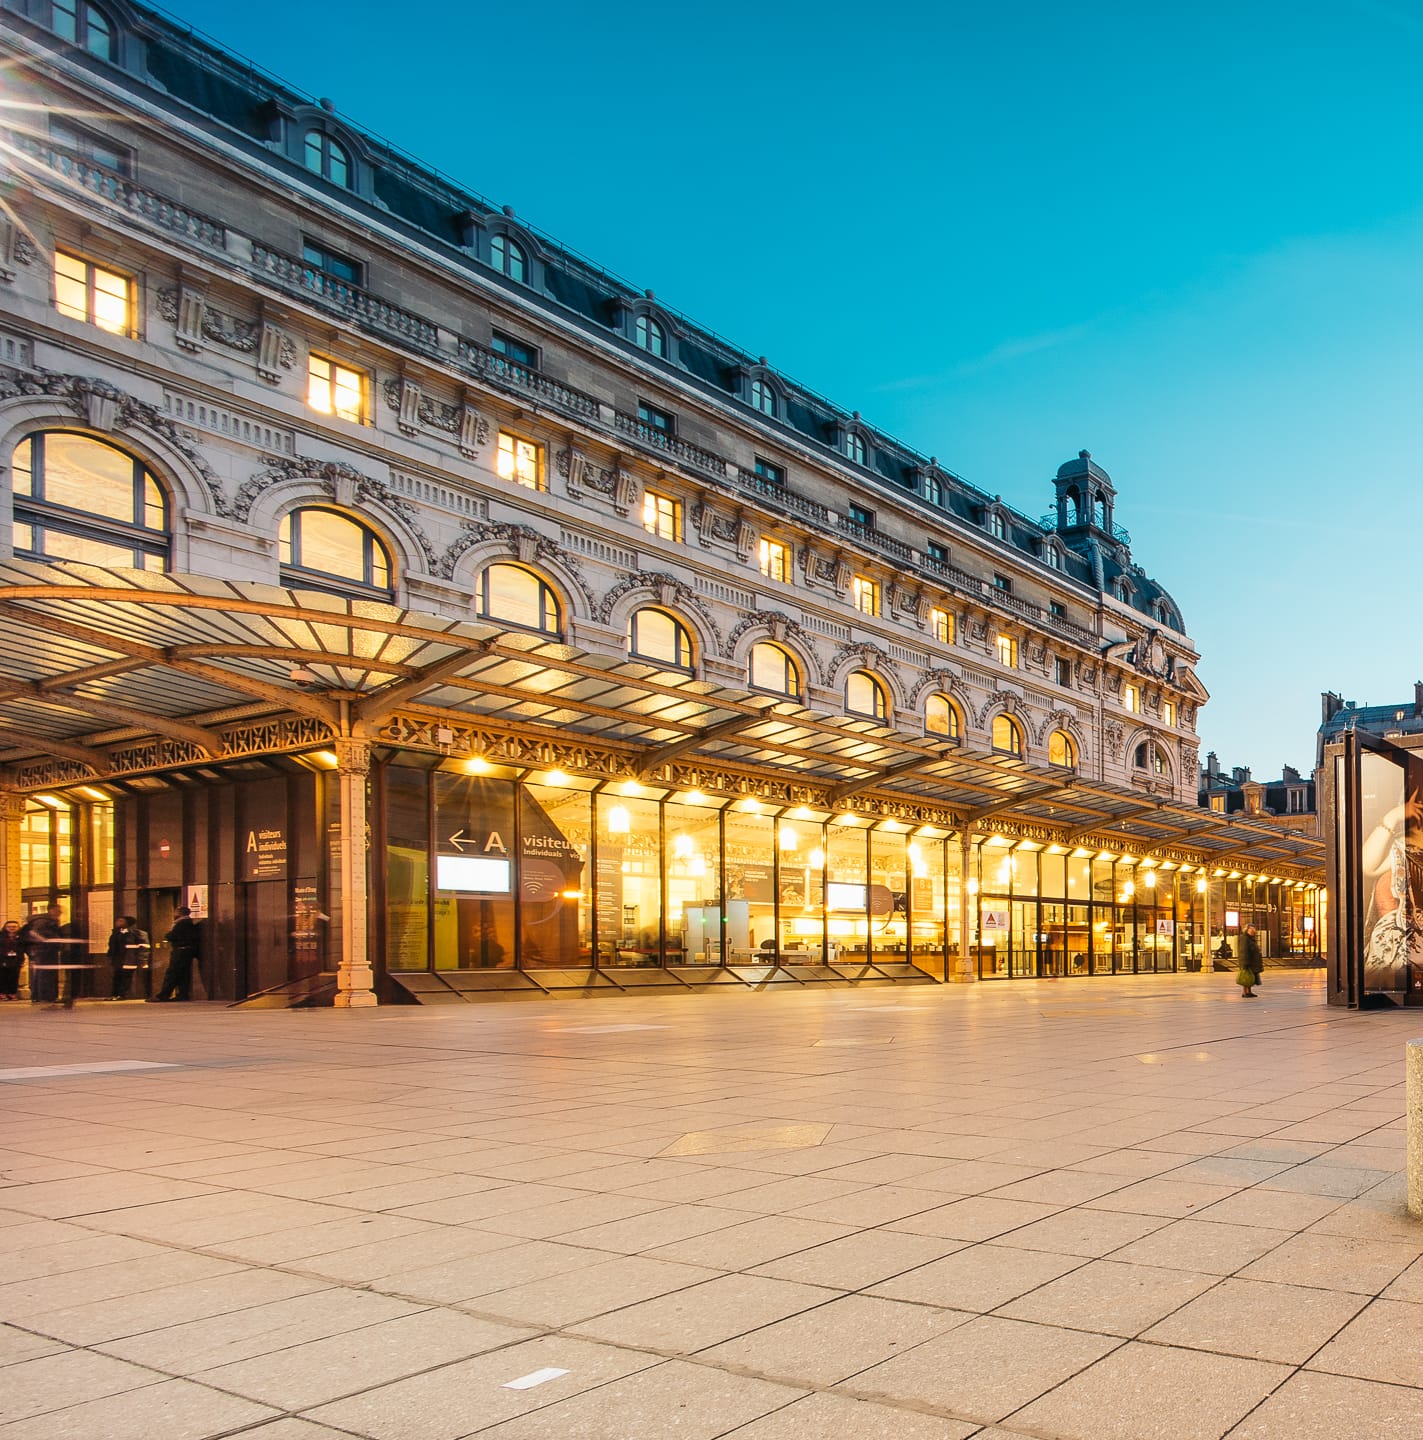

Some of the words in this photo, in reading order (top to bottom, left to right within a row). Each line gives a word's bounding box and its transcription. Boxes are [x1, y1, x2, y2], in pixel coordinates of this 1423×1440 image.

[246, 831, 258, 853] A
[484, 831, 505, 853] A
[523, 848, 563, 858] Individuals
